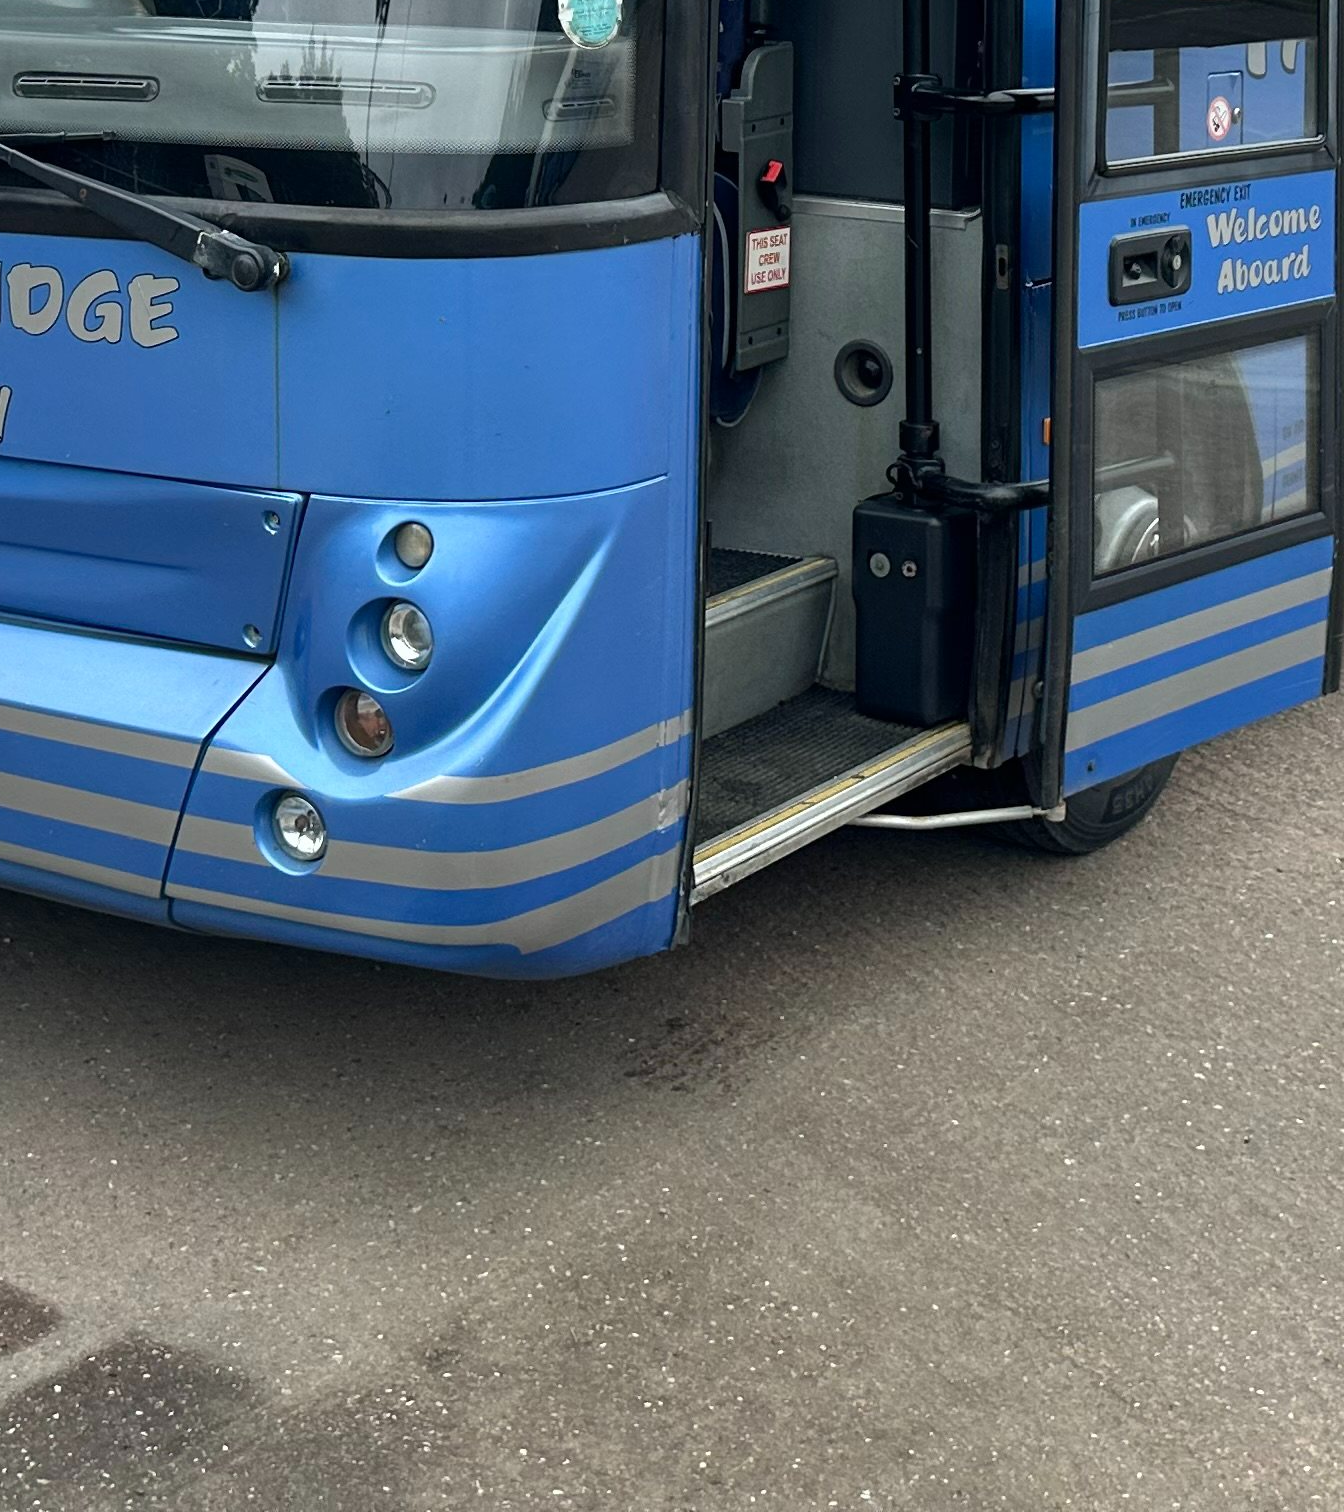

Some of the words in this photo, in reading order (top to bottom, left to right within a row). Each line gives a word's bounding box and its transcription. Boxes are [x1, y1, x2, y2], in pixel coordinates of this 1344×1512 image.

[1180, 188, 1232, 210] EMERGENCY
[1233, 183, 1252, 201] EXIT
[1130, 217, 1137, 228] IN
[1138, 212, 1171, 227] EMERGENCY
[1206, 204, 1322, 249] Welcome
[752, 237, 769, 251] THIS
[770, 233, 788, 248] SEAT
[759, 252, 781, 267] CREW
[1217, 244, 1312, 295] Aboard
[751, 270, 767, 285] USE
[768, 267, 786, 282] ONLY
[1118, 310, 1136, 323] PRESS
[1137, 305, 1159, 319] BUTTON
[1159, 303, 1167, 314] TO
[1167, 300, 1182, 313] OPEN
